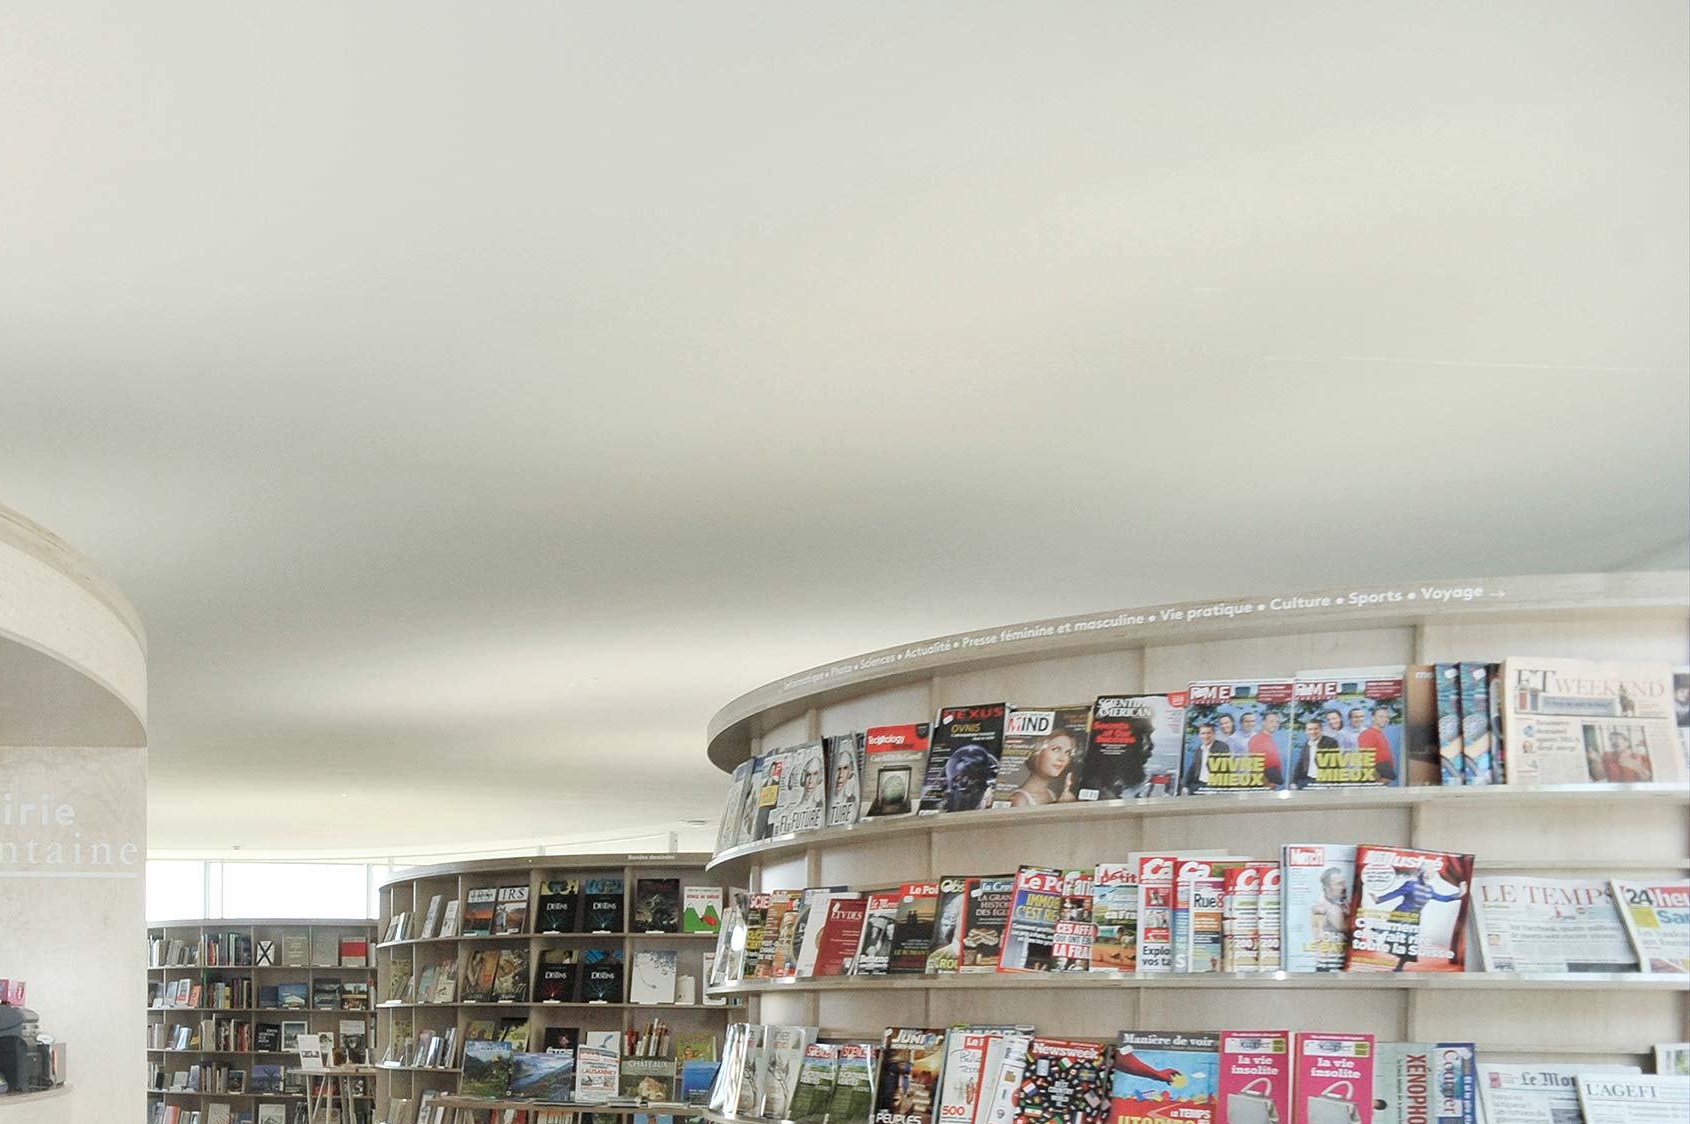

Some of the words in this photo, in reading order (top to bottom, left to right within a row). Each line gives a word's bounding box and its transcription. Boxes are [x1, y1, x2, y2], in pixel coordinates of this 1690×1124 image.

[859, 653, 896, 670] Sciences
[904, 639, 952, 660] Actualité
[961, 634, 998, 649] Presse
[1000, 624, 1055, 643] féminine
[1057, 620, 1072, 634] et
[1073, 613, 1144, 632] masculine
[1160, 608, 1184, 622] Vie
[1186, 601, 1254, 624] pratique
[1270, 594, 1331, 611] Culture
[1348, 590, 1404, 607] Sports
[1420, 586, 1484, 602] Voyage
[951, 722, 982, 734] OVNIS
[1008, 716, 1050, 733] MIND
[868, 735, 905, 746] Tecology
[1208, 755, 1265, 773] VIVRE
[1316, 751, 1377, 769] VIVRE
[1207, 772, 1265, 788] MIEUX
[1316, 768, 1376, 783] MIEUX
[1019, 870, 1041, 889] Le
[910, 885, 921, 895] Le
[1481, 885, 1517, 903] LE
[1522, 885, 1613, 906] TEMPS
[1624, 887, 1653, 906] 24
[1392, 942, 1407, 955] la
[1123, 1032, 1171, 1045] Manière
[1173, 1035, 1187, 1046] de
[1189, 1036, 1214, 1047] voir
[1032, 1041, 1099, 1060] Newsweek
[1237, 1055, 1250, 1065] la
[1252, 1056, 1273, 1066] vie
[1317, 1057, 1332, 1067] la
[1334, 1058, 1355, 1068] vie
[1231, 1065, 1279, 1076] insolite
[1310, 1068, 1361, 1079] insolite
[1443, 1049, 1459, 1114] Courrier
[1520, 1071, 1541, 1086] Le
[1585, 1083, 1658, 1099] L'AGEFI
[941, 1105, 966, 1116] 500
